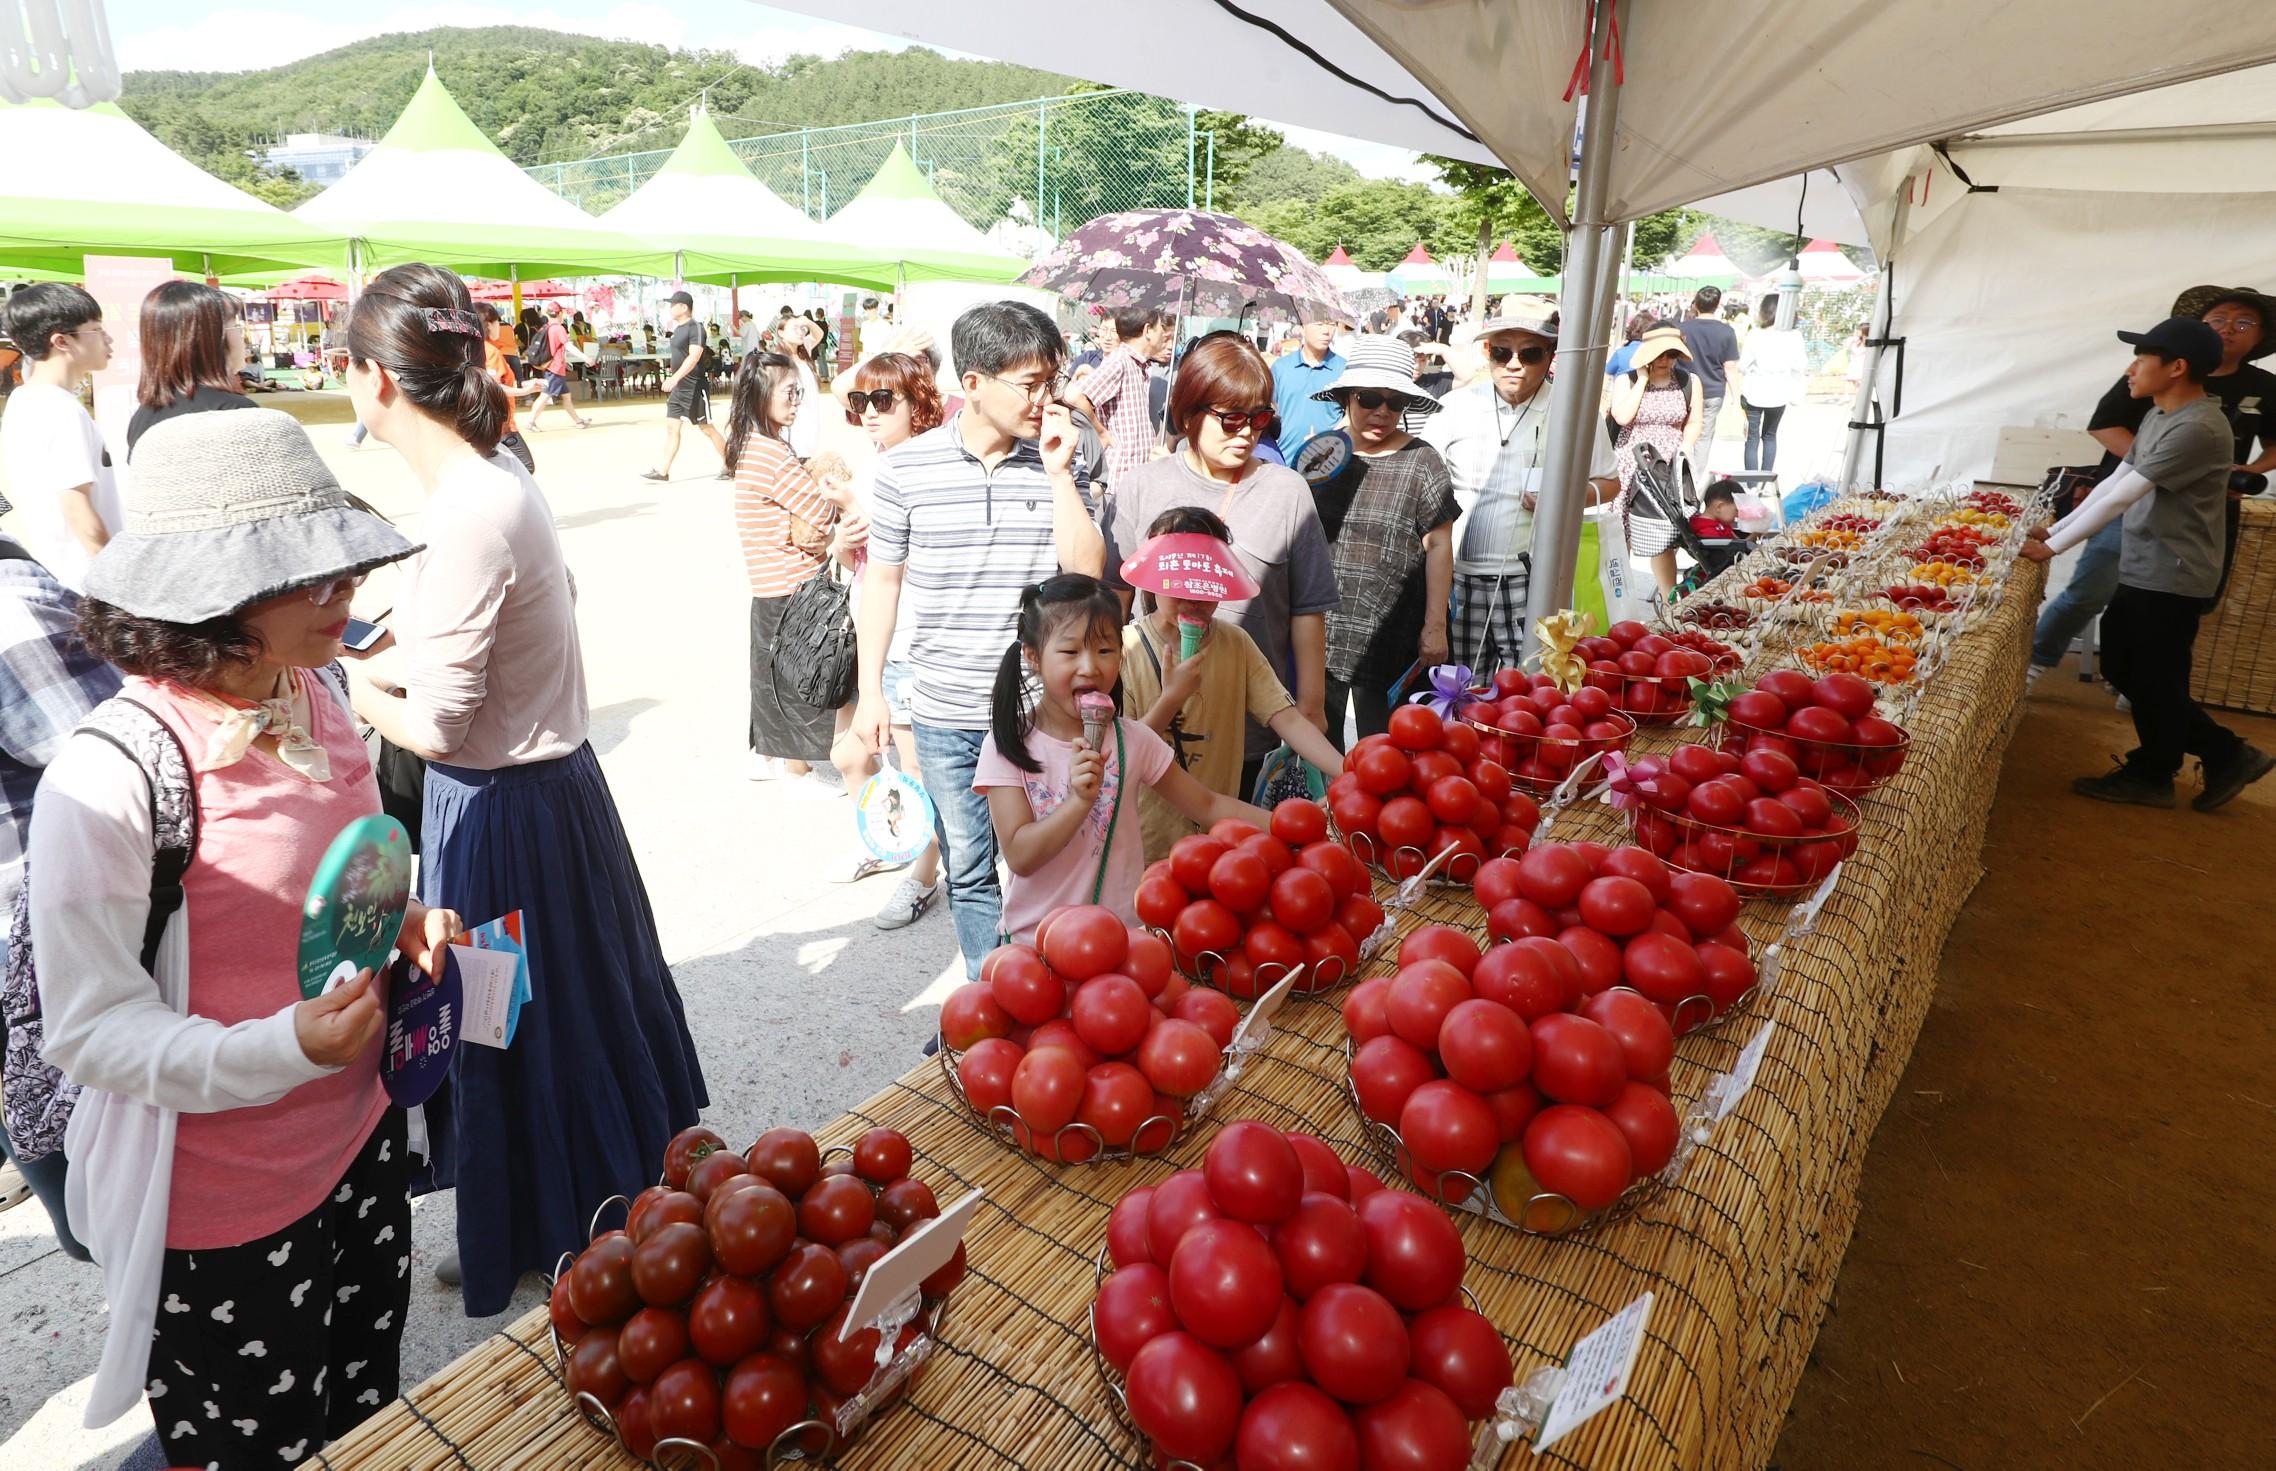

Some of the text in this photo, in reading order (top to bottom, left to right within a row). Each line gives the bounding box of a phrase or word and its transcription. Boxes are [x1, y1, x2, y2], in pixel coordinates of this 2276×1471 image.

[1158, 560, 1234, 577] 퇴촌 토마토 축제
